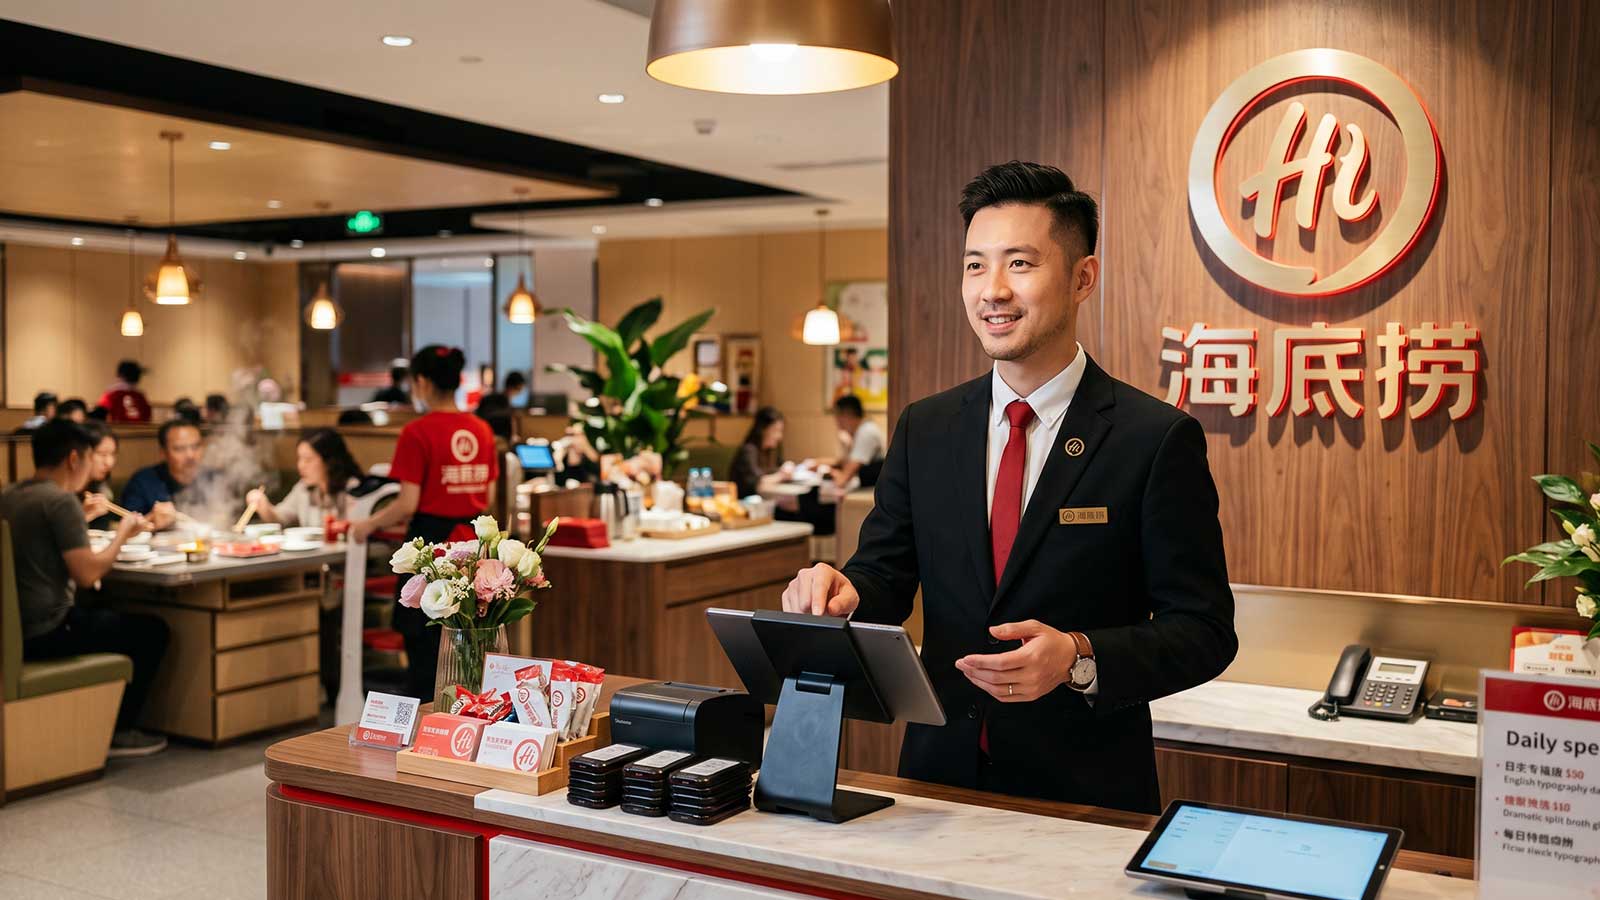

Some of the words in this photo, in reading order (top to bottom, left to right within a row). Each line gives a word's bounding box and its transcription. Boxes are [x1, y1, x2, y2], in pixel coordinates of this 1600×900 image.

[1239, 101, 1379, 240] Hi
[1161, 321, 1481, 421] 海底捞
[1567, 695, 1600, 713] 海底
[456, 730, 473, 750] Hi
[1506, 730, 1557, 755] Daily
[1563, 740, 1600, 759] spe
[519, 745, 536, 766] Hi
[1504, 774, 1536, 787] English
[1537, 780, 1588, 795] typography
[1503, 808, 1543, 822] Dramatic
[1545, 813, 1564, 825] split
[1566, 816, 1591, 828] broth
